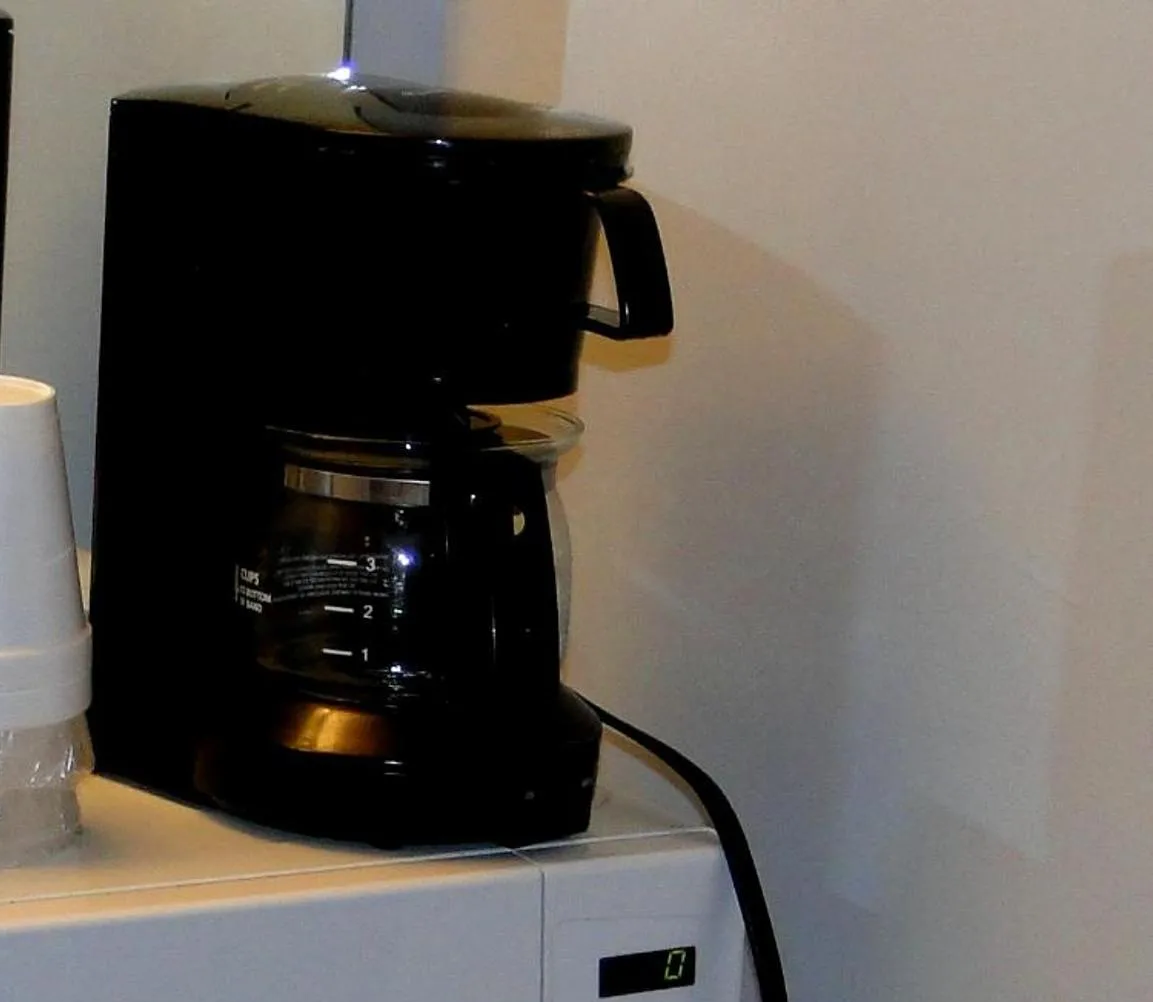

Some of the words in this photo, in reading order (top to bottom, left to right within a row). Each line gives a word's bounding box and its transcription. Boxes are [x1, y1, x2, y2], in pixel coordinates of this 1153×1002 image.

[365, 556, 376, 573] 3
[363, 604, 374, 620] 2
[361, 647, 369, 662] 1
[664, 949, 686, 981] 0
